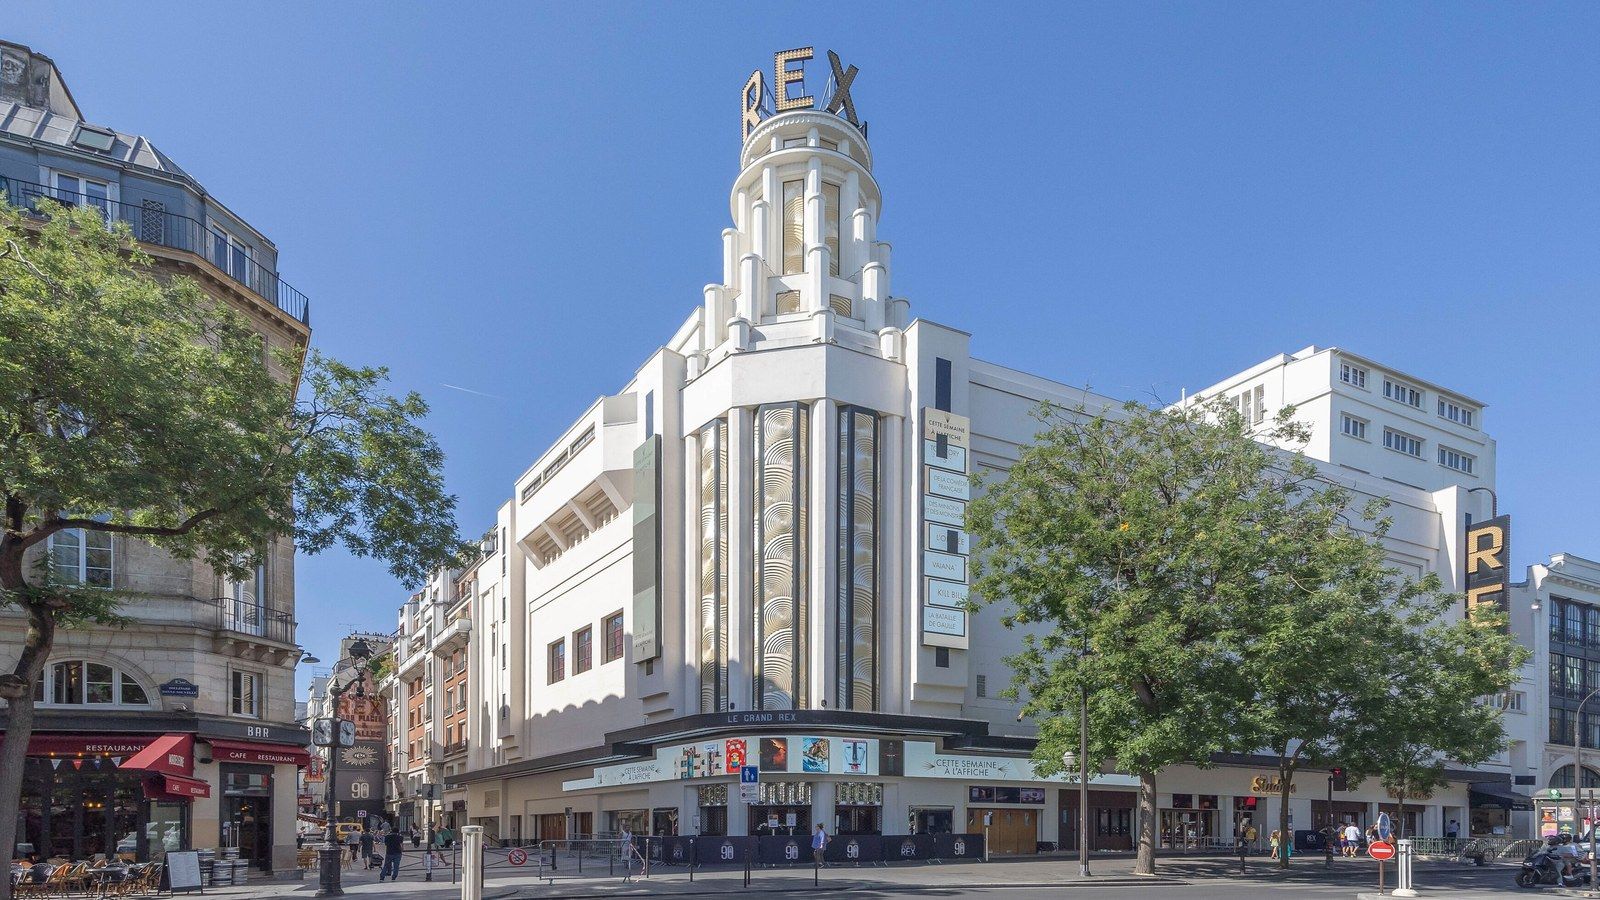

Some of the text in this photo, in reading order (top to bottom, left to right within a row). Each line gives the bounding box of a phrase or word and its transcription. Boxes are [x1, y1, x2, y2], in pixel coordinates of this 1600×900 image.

[742, 46, 859, 145] REX
[727, 713, 796, 723] LE GRAND REX
[247, 726, 269, 738] BAR
[936, 758, 997, 769] CETTE SEMAINE
[944, 766, 989, 777] À L'AFFICHE
[721, 845, 734, 860] 90
[785, 845, 799, 860] 90
[846, 844, 859, 859] 90
[901, 847, 916, 857] REX
[954, 842, 966, 855] 90
